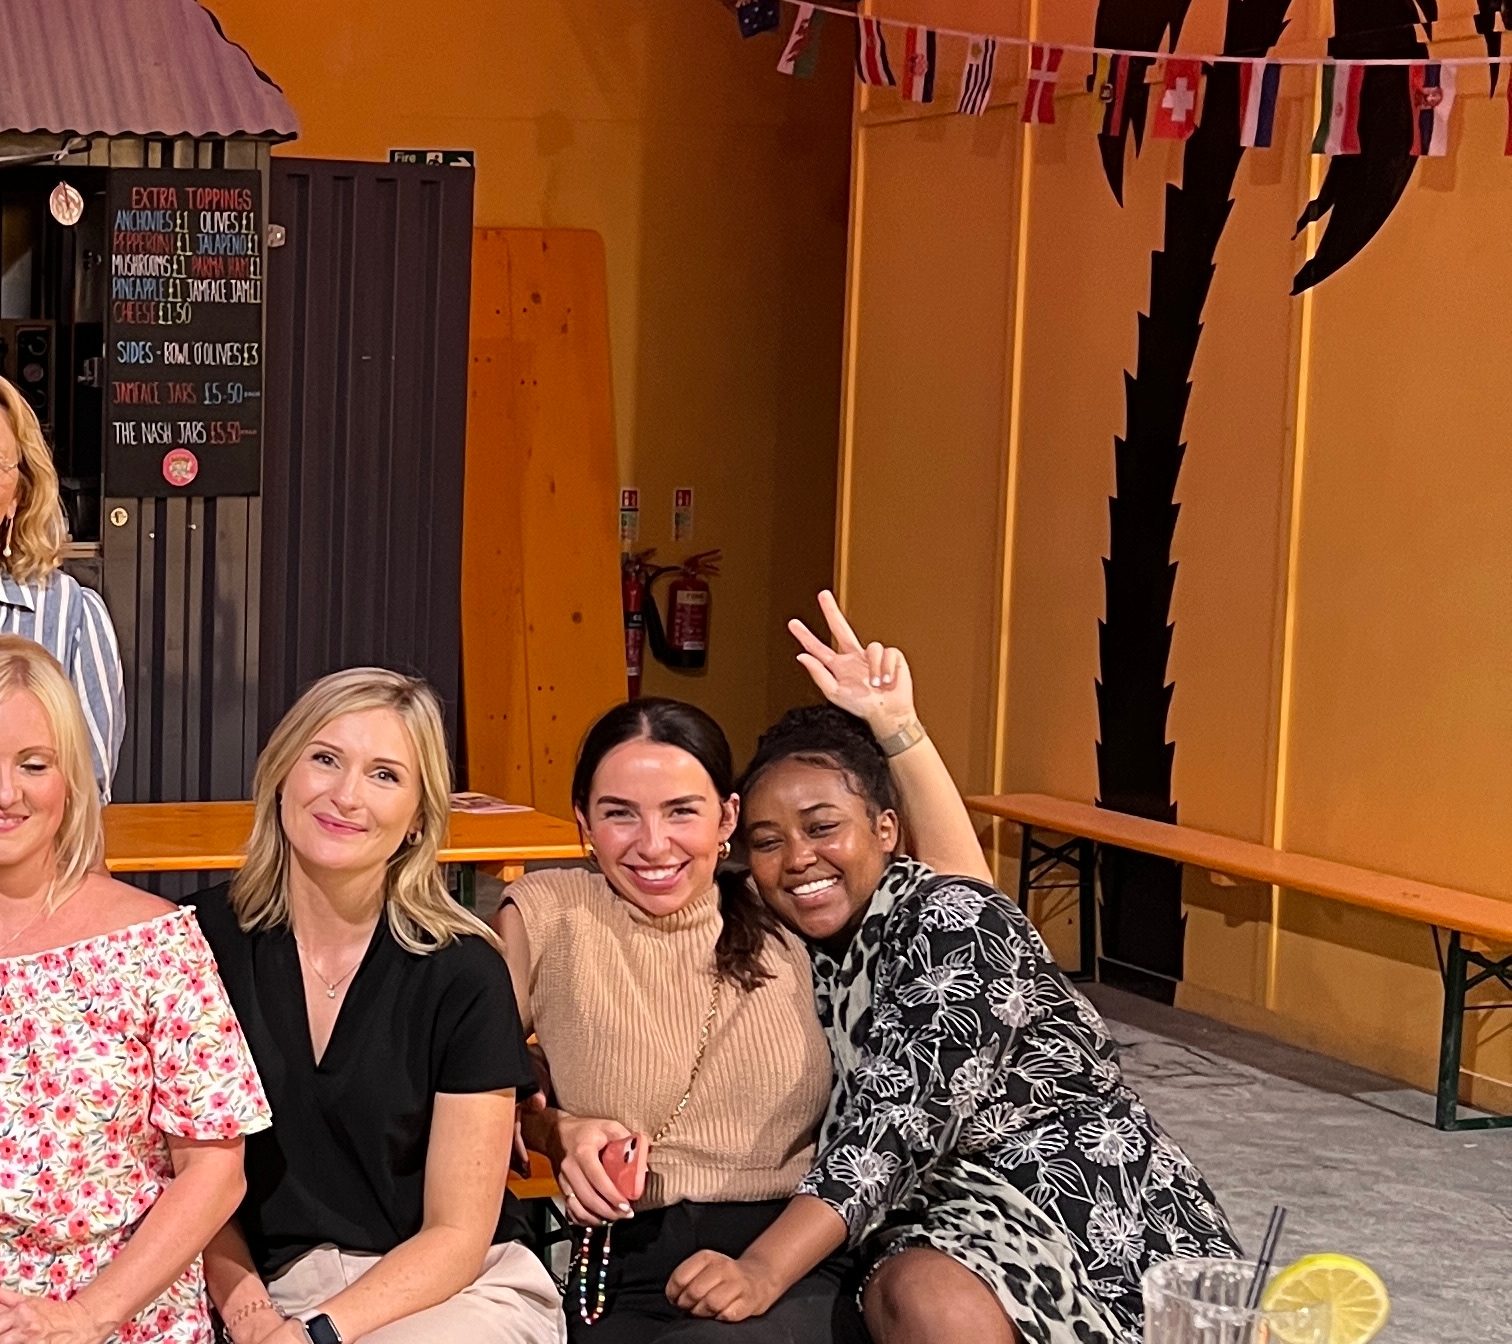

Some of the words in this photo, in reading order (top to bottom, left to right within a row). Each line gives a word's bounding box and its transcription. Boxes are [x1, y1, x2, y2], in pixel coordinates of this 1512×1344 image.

[132, 187, 178, 209] EXTRA
[184, 187, 252, 210] TOPPINGS
[114, 209, 174, 232] ANCHOVIES
[174, 210, 189, 233] £1
[199, 211, 239, 233] OLIVES
[241, 211, 256, 234] £1
[113, 231, 175, 254] PEPPERONI
[176, 233, 193, 255] £1
[247, 234, 260, 256] £1
[112, 253, 171, 276] MUSHROOMS
[172, 255, 188, 278] £1
[249, 257, 263, 279] £1
[112, 277, 167, 300] PINEAPPLE
[168, 278, 182, 302] £1
[113, 301, 157, 324] CHEESE
[116, 341, 154, 364] SIDES
[163, 341, 191, 365] BOWL
[203, 342, 242, 366] OLIVES
[243, 342, 259, 366] £3
[167, 381, 197, 404] JARS
[112, 421, 138, 445] THE
[141, 421, 173, 444] NASH
[177, 421, 207, 444] JARS
